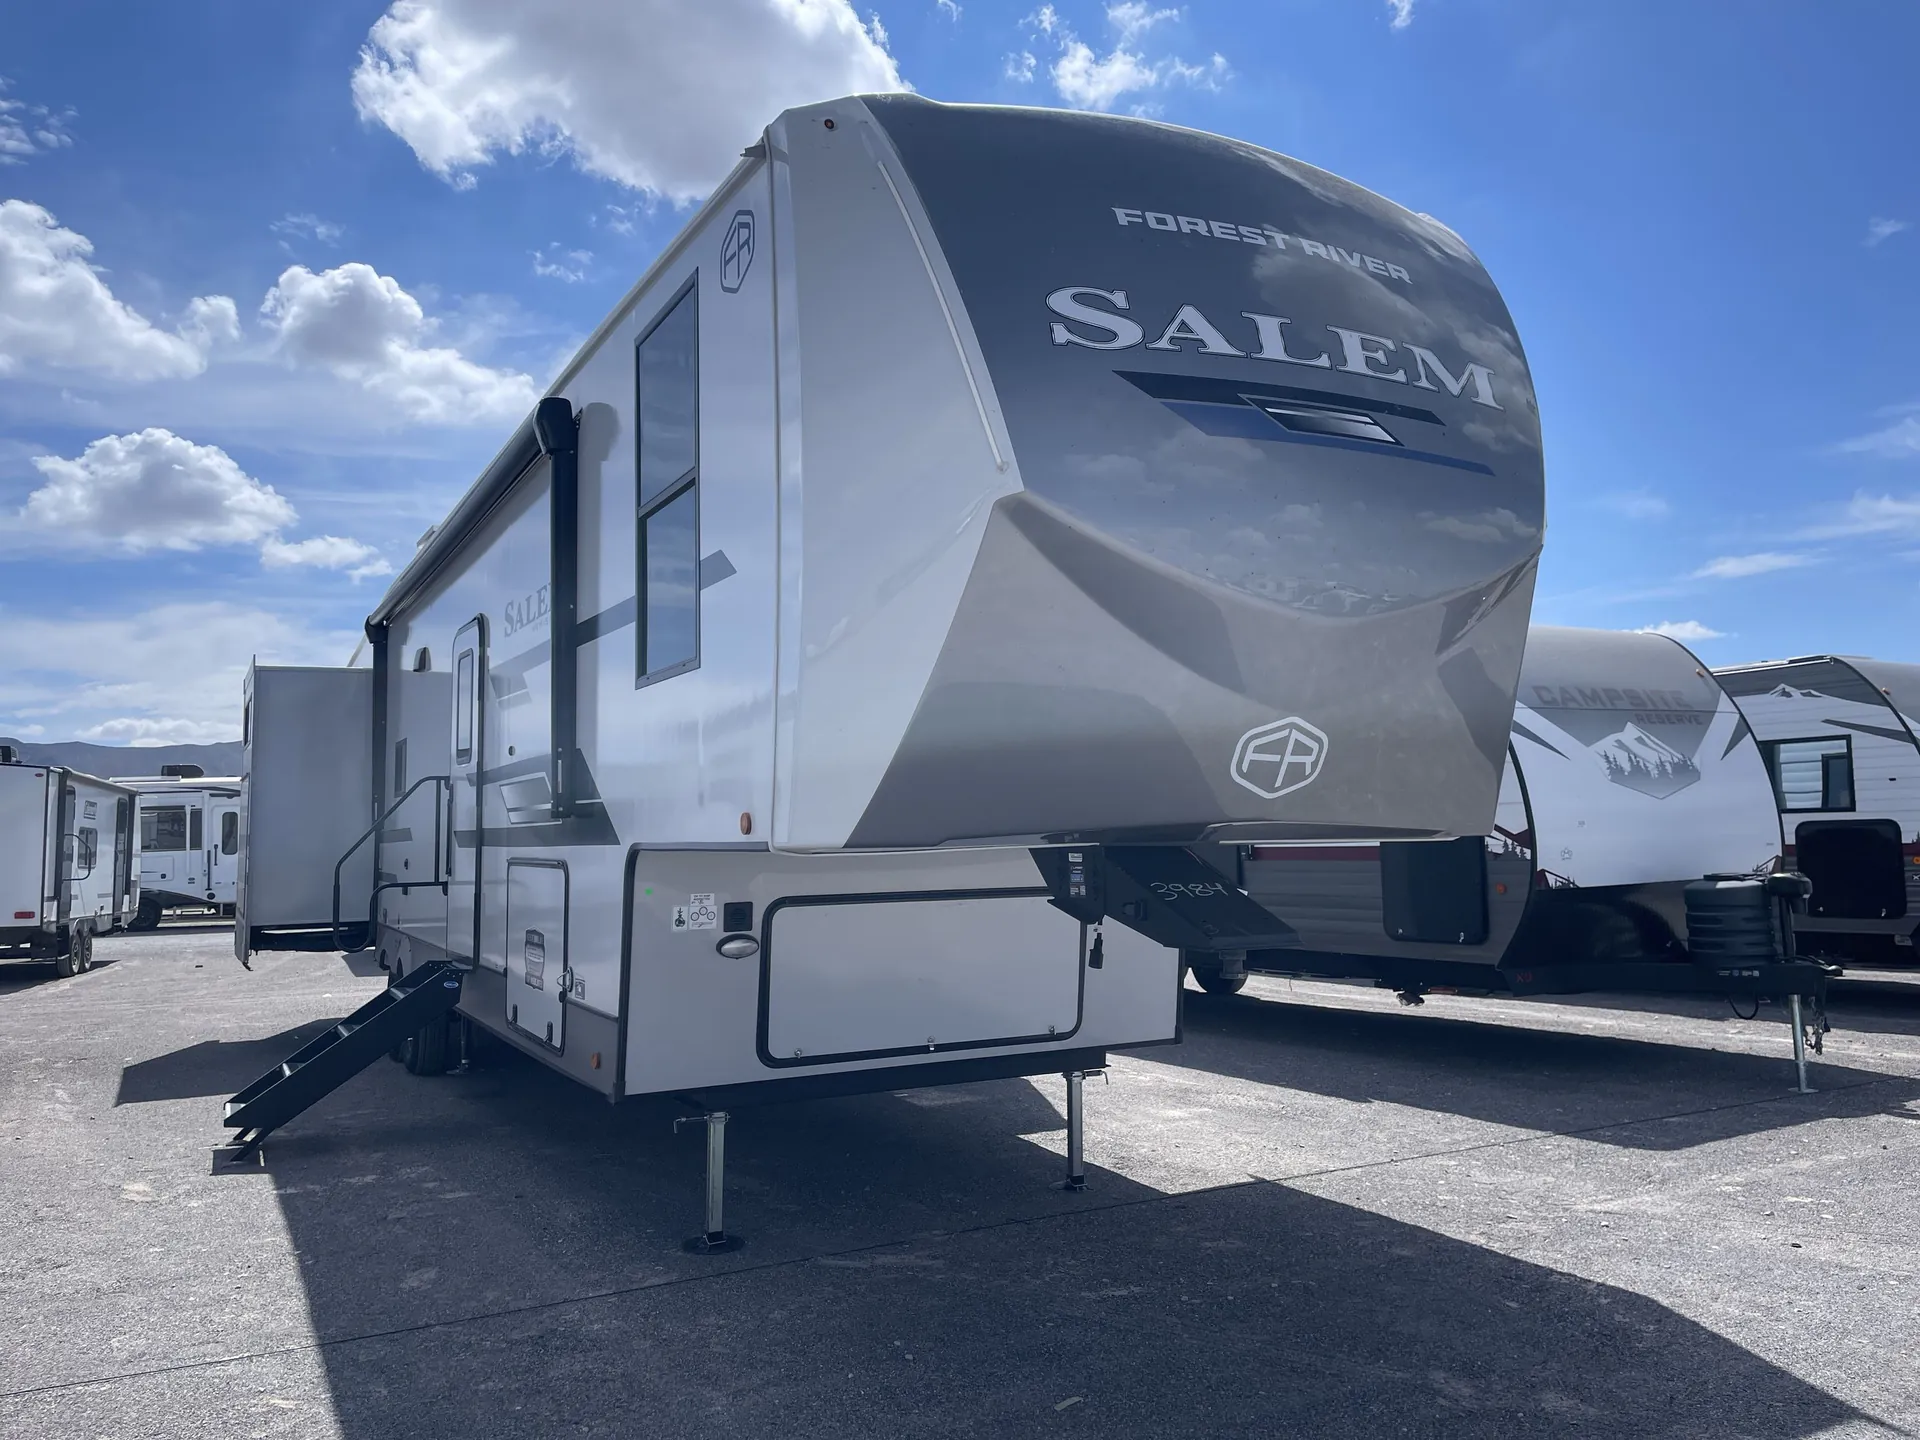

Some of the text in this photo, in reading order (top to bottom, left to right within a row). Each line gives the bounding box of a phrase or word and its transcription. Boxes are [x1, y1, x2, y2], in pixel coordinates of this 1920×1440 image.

[1111, 207, 1413, 284] FOREST RIVER
[1045, 285, 1505, 411] SALEM
[504, 582, 551, 638] SALE
[1531, 685, 1695, 710] CAMPSITE
[1634, 713, 1704, 726] RESERVE
[1150, 882, 1229, 901] 3984
